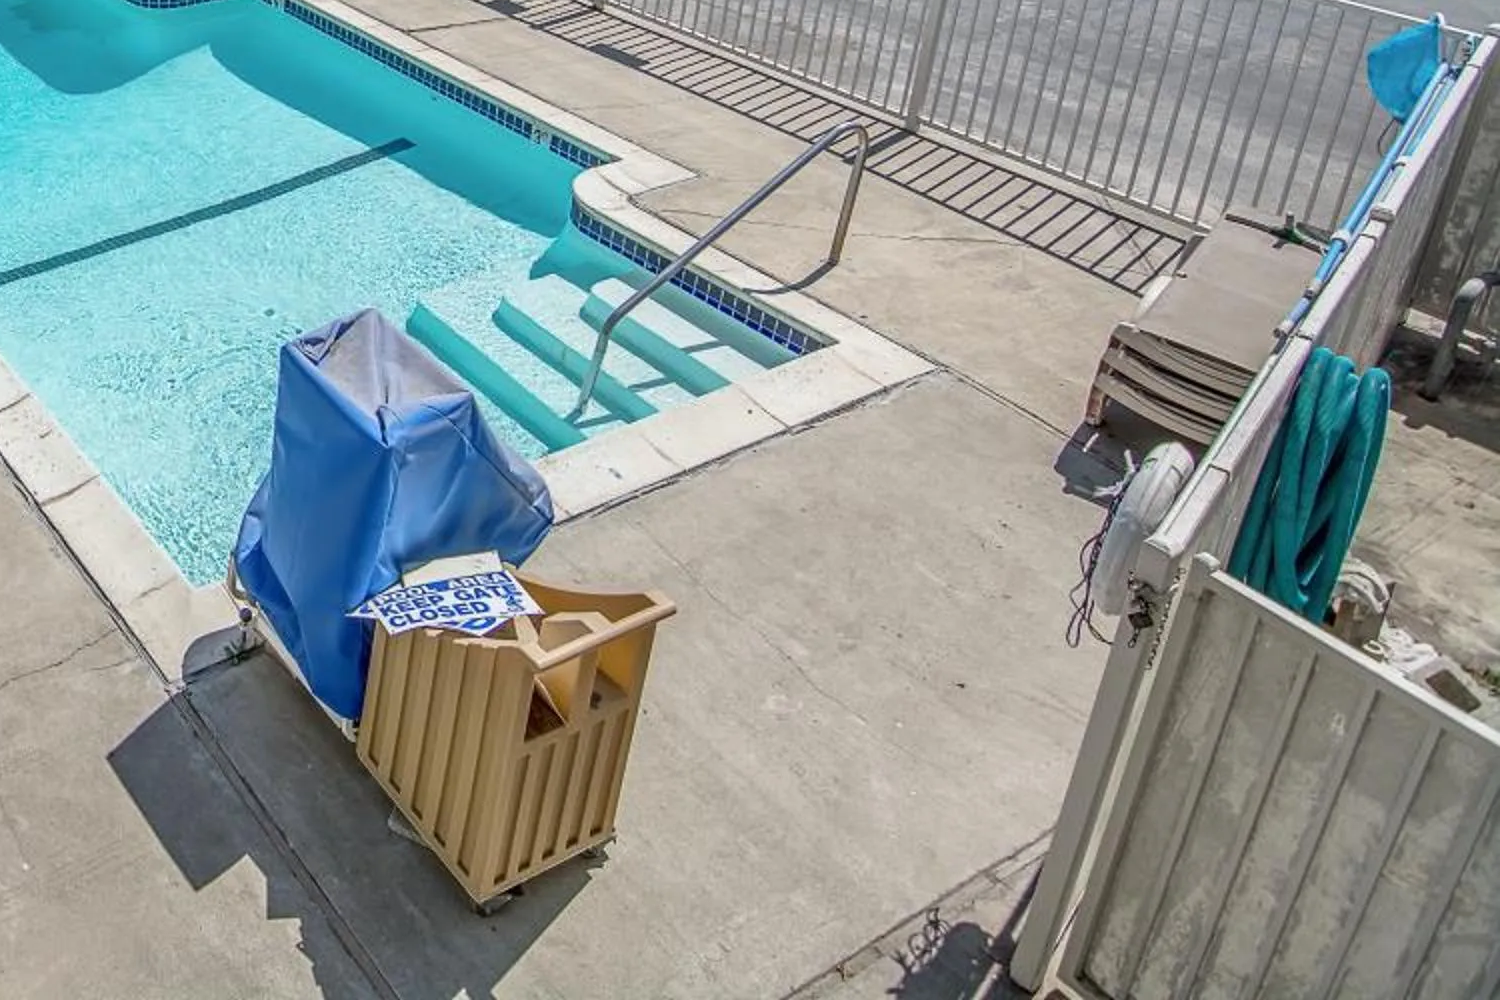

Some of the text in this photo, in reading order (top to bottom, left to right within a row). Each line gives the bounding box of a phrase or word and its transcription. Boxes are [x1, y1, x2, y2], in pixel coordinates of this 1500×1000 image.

[376, 572, 509, 603] POOL AREA
[379, 583, 516, 617] KEEP GATE
[389, 601, 490, 627] CLOSED
